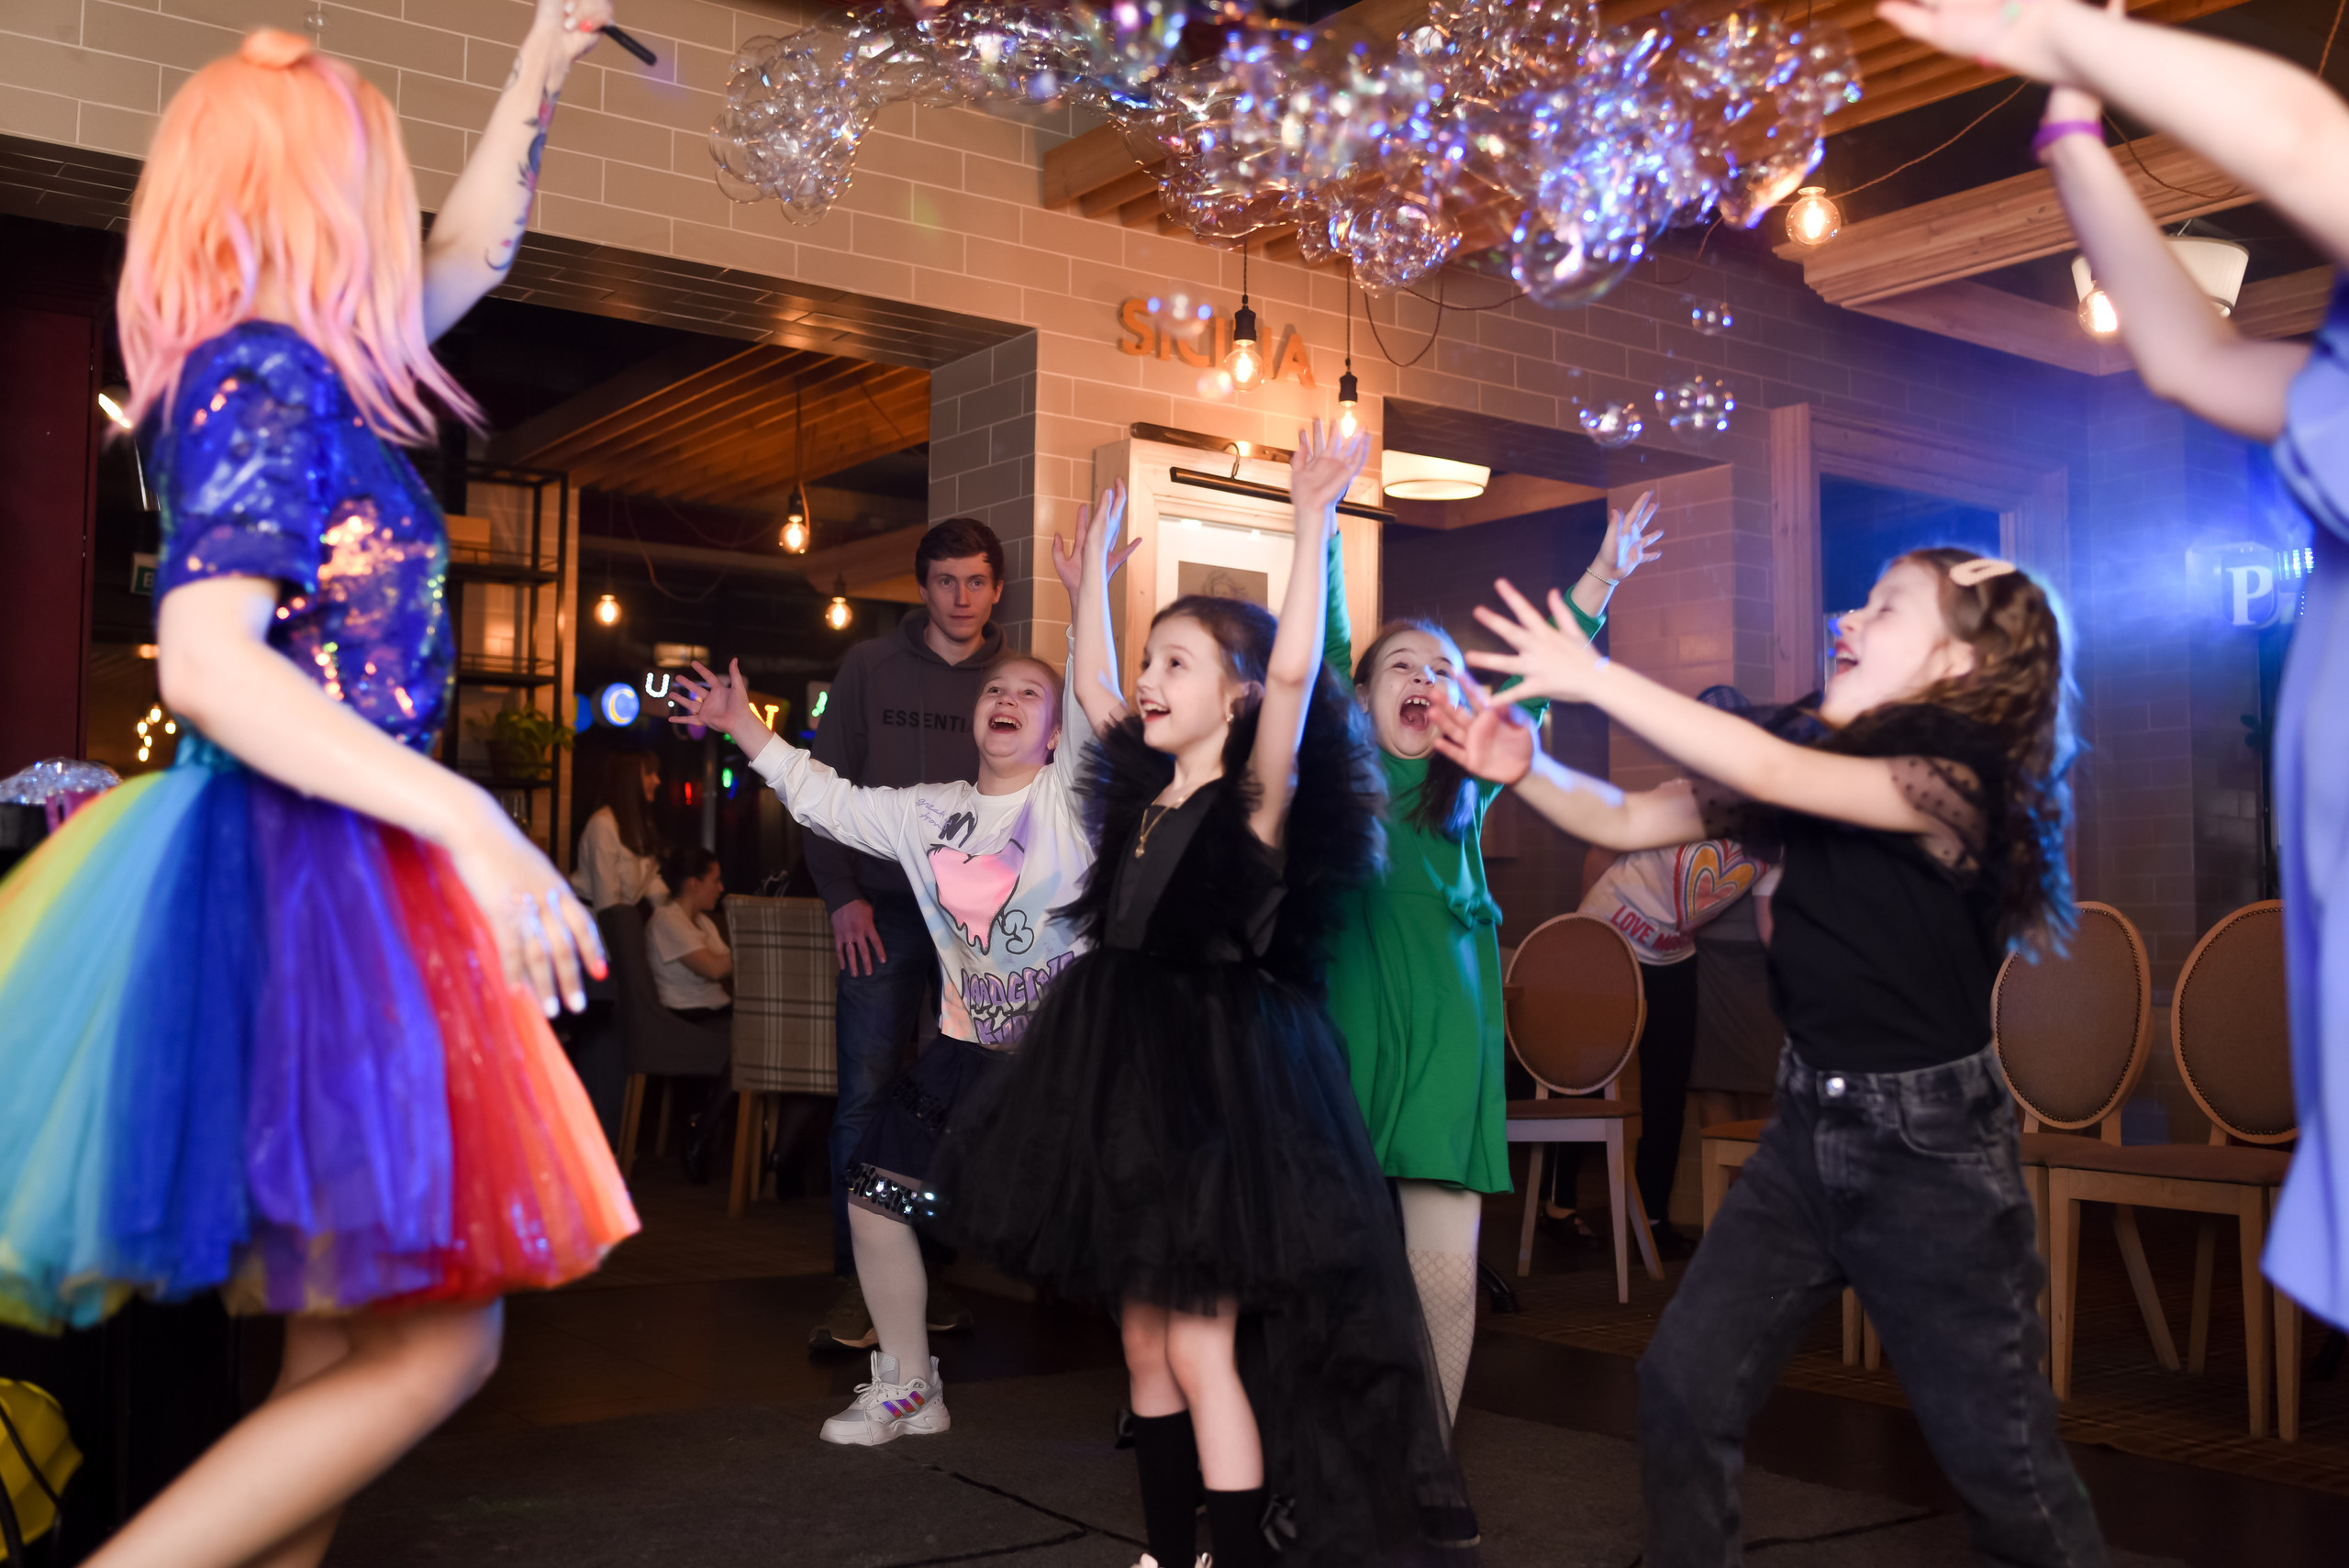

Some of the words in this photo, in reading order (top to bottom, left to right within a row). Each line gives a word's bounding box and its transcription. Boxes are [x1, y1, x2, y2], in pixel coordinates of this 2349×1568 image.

[1119, 298, 1317, 389] SICIIA
[883, 709, 971, 734] ESSENTI
[1610, 905, 1654, 945] LOVE
